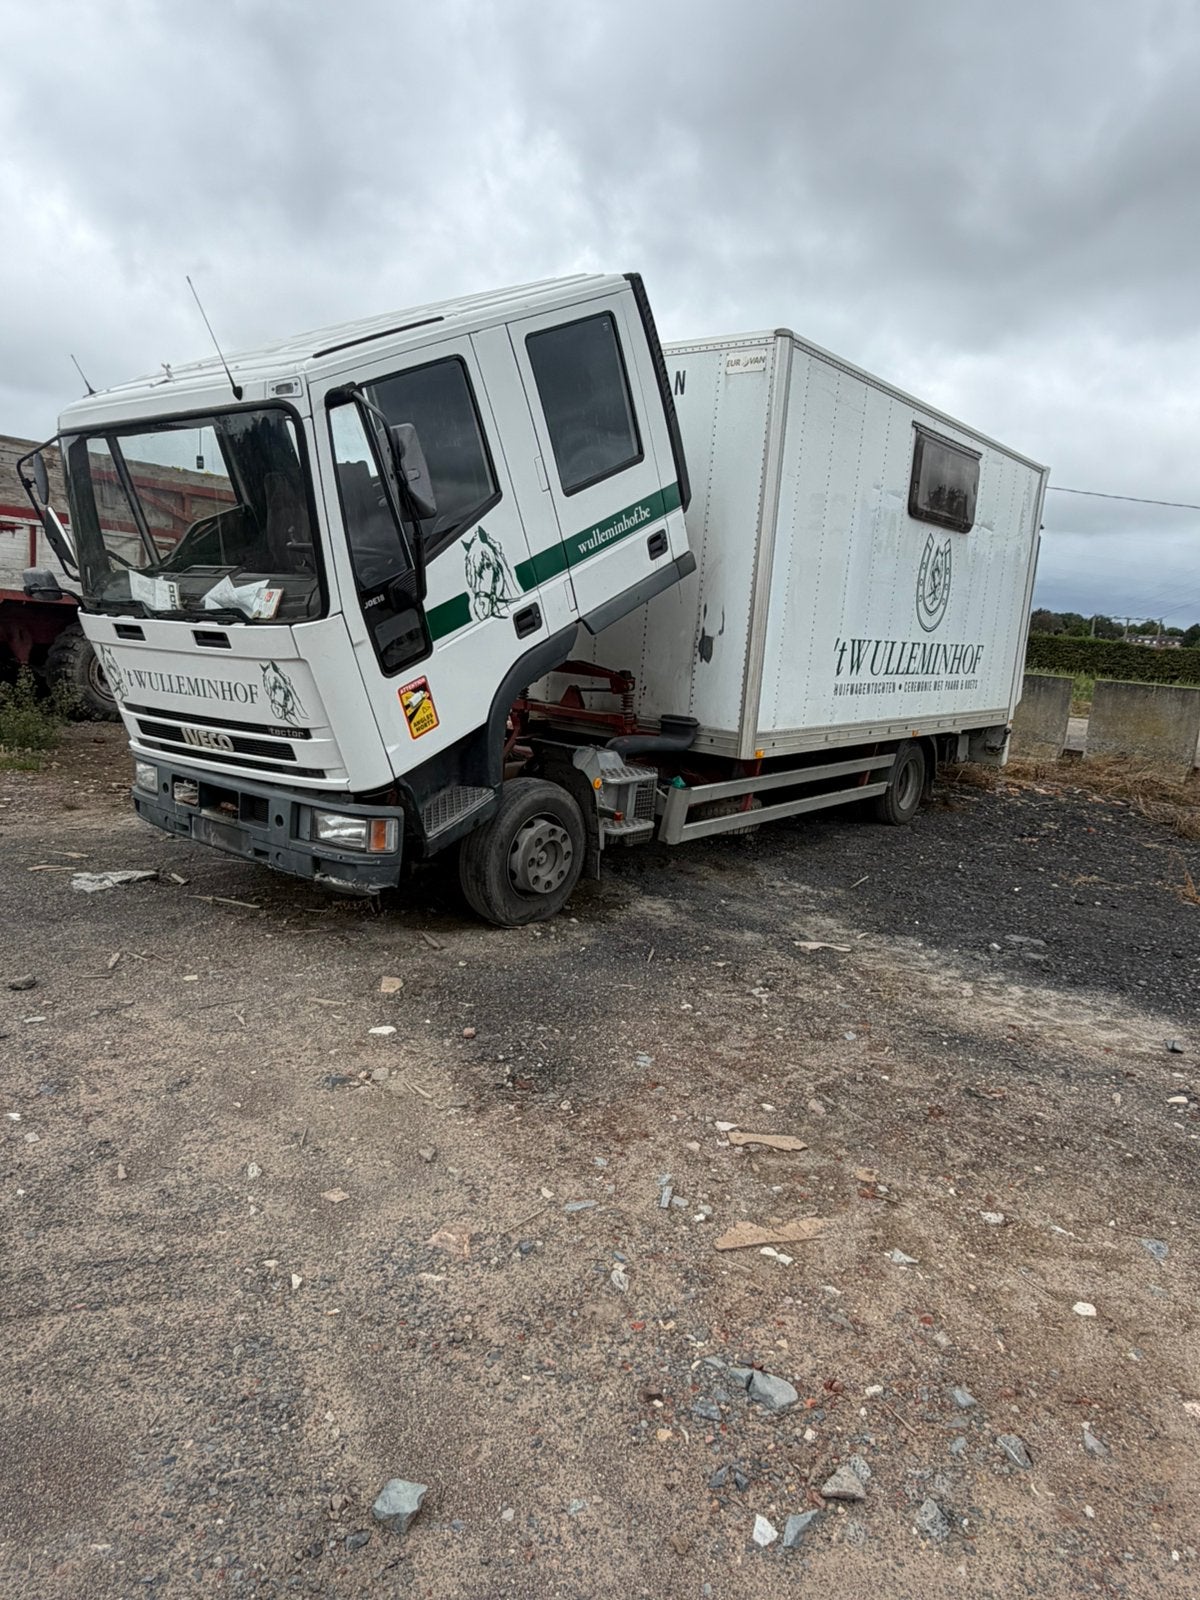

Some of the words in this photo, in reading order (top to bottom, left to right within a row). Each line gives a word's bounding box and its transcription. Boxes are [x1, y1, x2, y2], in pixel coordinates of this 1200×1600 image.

[577, 505, 651, 554] wulleminhof.be
[181, 727, 235, 752] IVECO
[270, 727, 304, 738] tector
